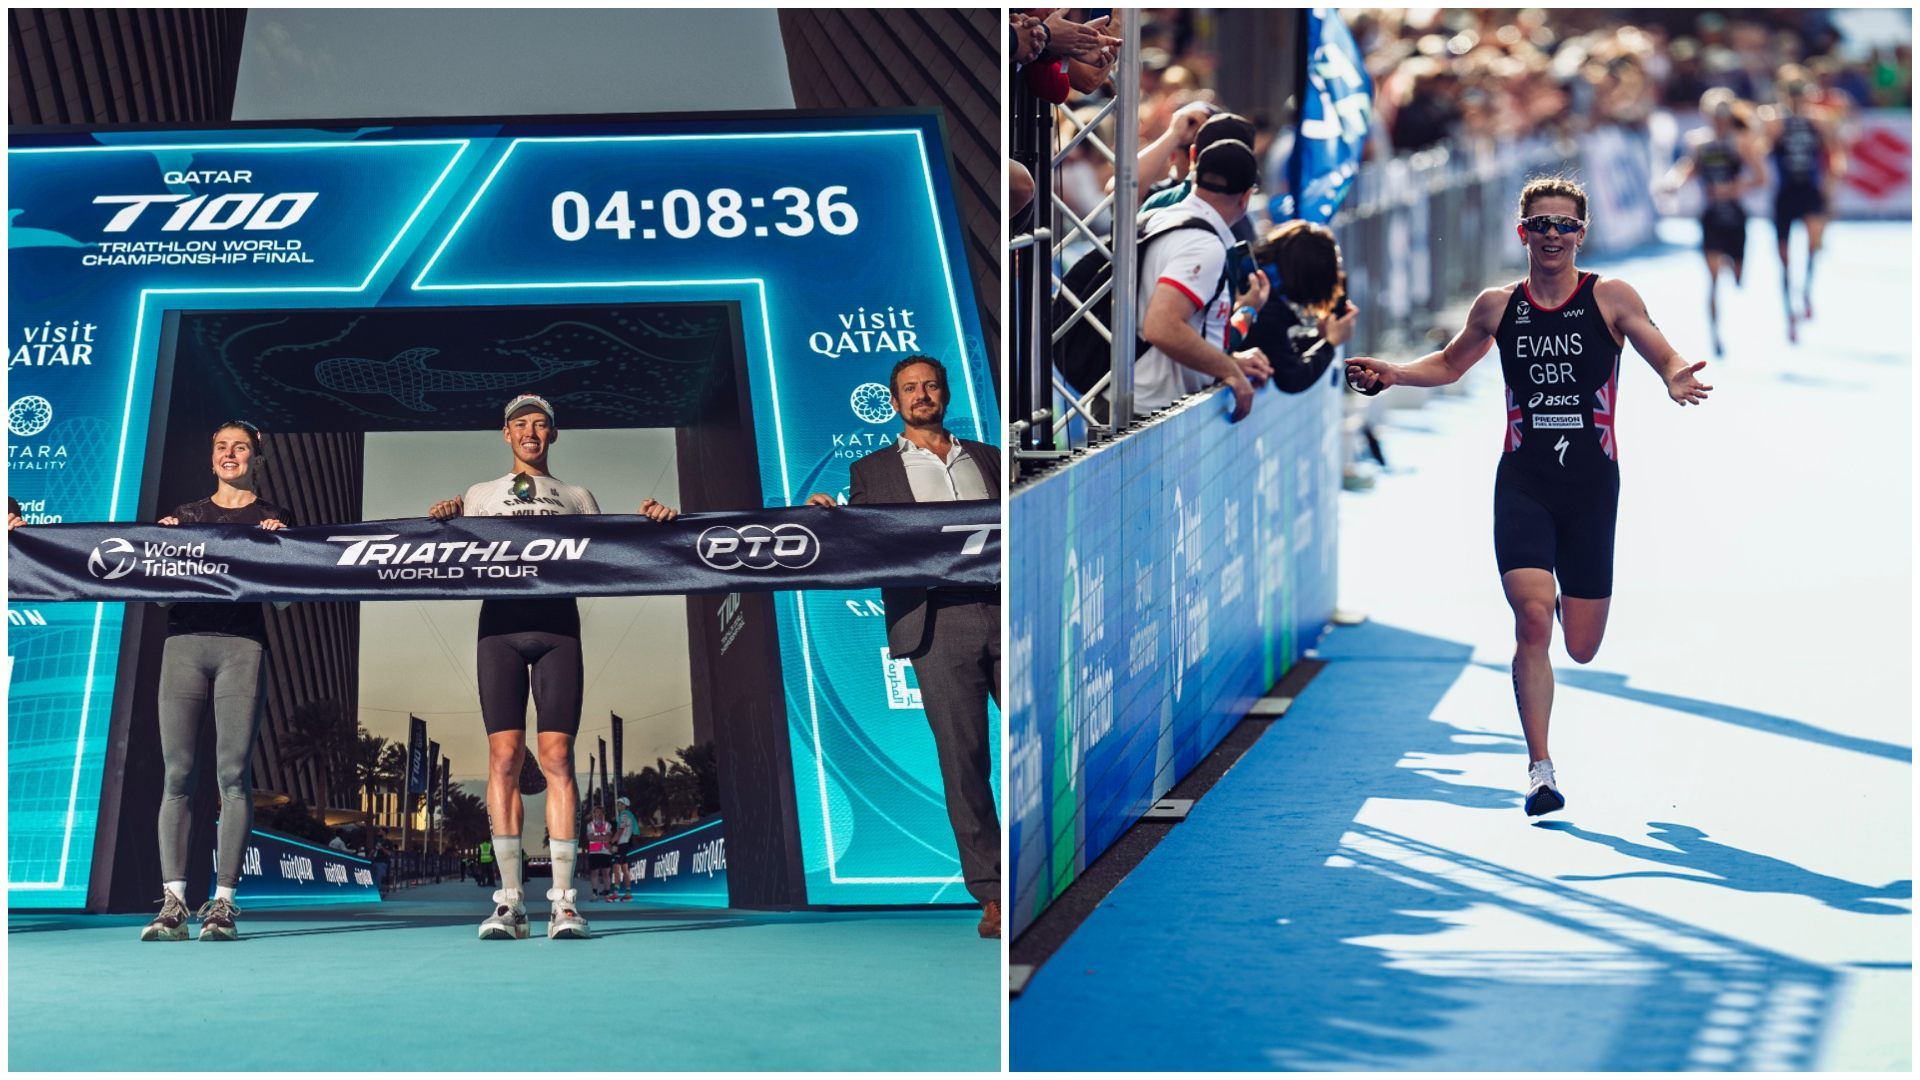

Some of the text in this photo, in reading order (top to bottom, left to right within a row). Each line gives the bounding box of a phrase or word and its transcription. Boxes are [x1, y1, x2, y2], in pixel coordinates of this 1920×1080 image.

[164, 170, 252, 185] QATAR
[92, 192, 319, 232] T100
[551, 185, 859, 241] 04:08:36
[98, 239, 302, 253] TRIATHLON WORLD
[82, 252, 314, 266] CHAMPIONSHIP FINAL
[838, 306, 915, 330] visit
[23, 320, 98, 343] visit
[809, 330, 921, 358] QATAR
[1516, 333, 1583, 358] EVANS
[8, 343, 93, 371] ATAR
[1529, 363, 1577, 384] GBR
[1545, 394, 1580, 406] asics
[832, 432, 899, 447] KATA
[16, 499, 46, 512] orld
[144, 542, 205, 558] World
[326, 534, 590, 566] TRIATHLON
[705, 535, 809, 559] PTO
[142, 560, 230, 577] Triathlon
[377, 565, 538, 580] WORLD TOUR
